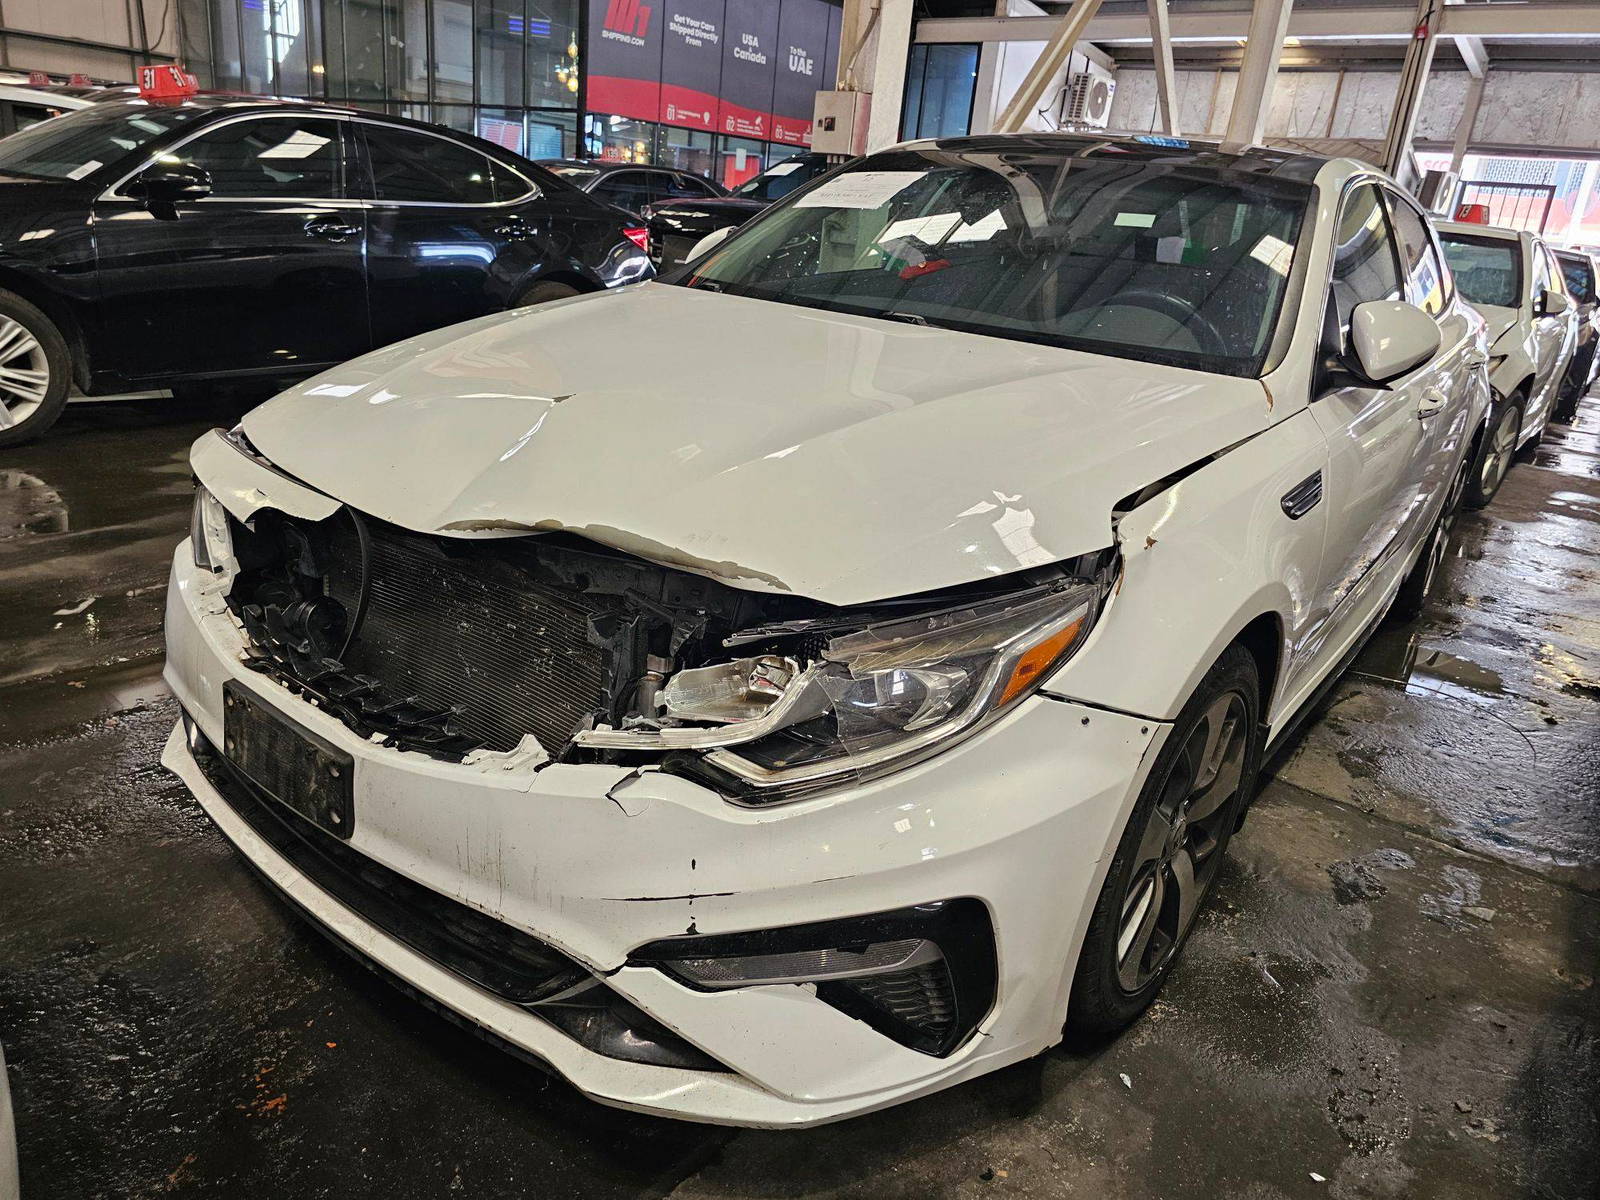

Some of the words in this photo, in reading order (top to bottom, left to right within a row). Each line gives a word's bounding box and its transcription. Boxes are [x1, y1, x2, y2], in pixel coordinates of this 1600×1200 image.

[673, 14, 686, 24] Get
[686, 16, 700, 28] Your
[700, 21, 715, 32] Cars
[669, 22, 695, 36] Shipped
[694, 29, 719, 45] Directly
[685, 35, 702, 47] From
[742, 33, 759, 47] USA
[733, 46, 767, 65] Canada
[789, 46, 798, 55] To
[797, 48, 807, 58] the
[788, 54, 814, 76] UAE
[143, 68, 156, 90] 31
[169, 66, 187, 88] 31
[667, 107, 675, 121] 01
[726, 119, 735, 132] 02
[775, 127, 783, 140] 03
